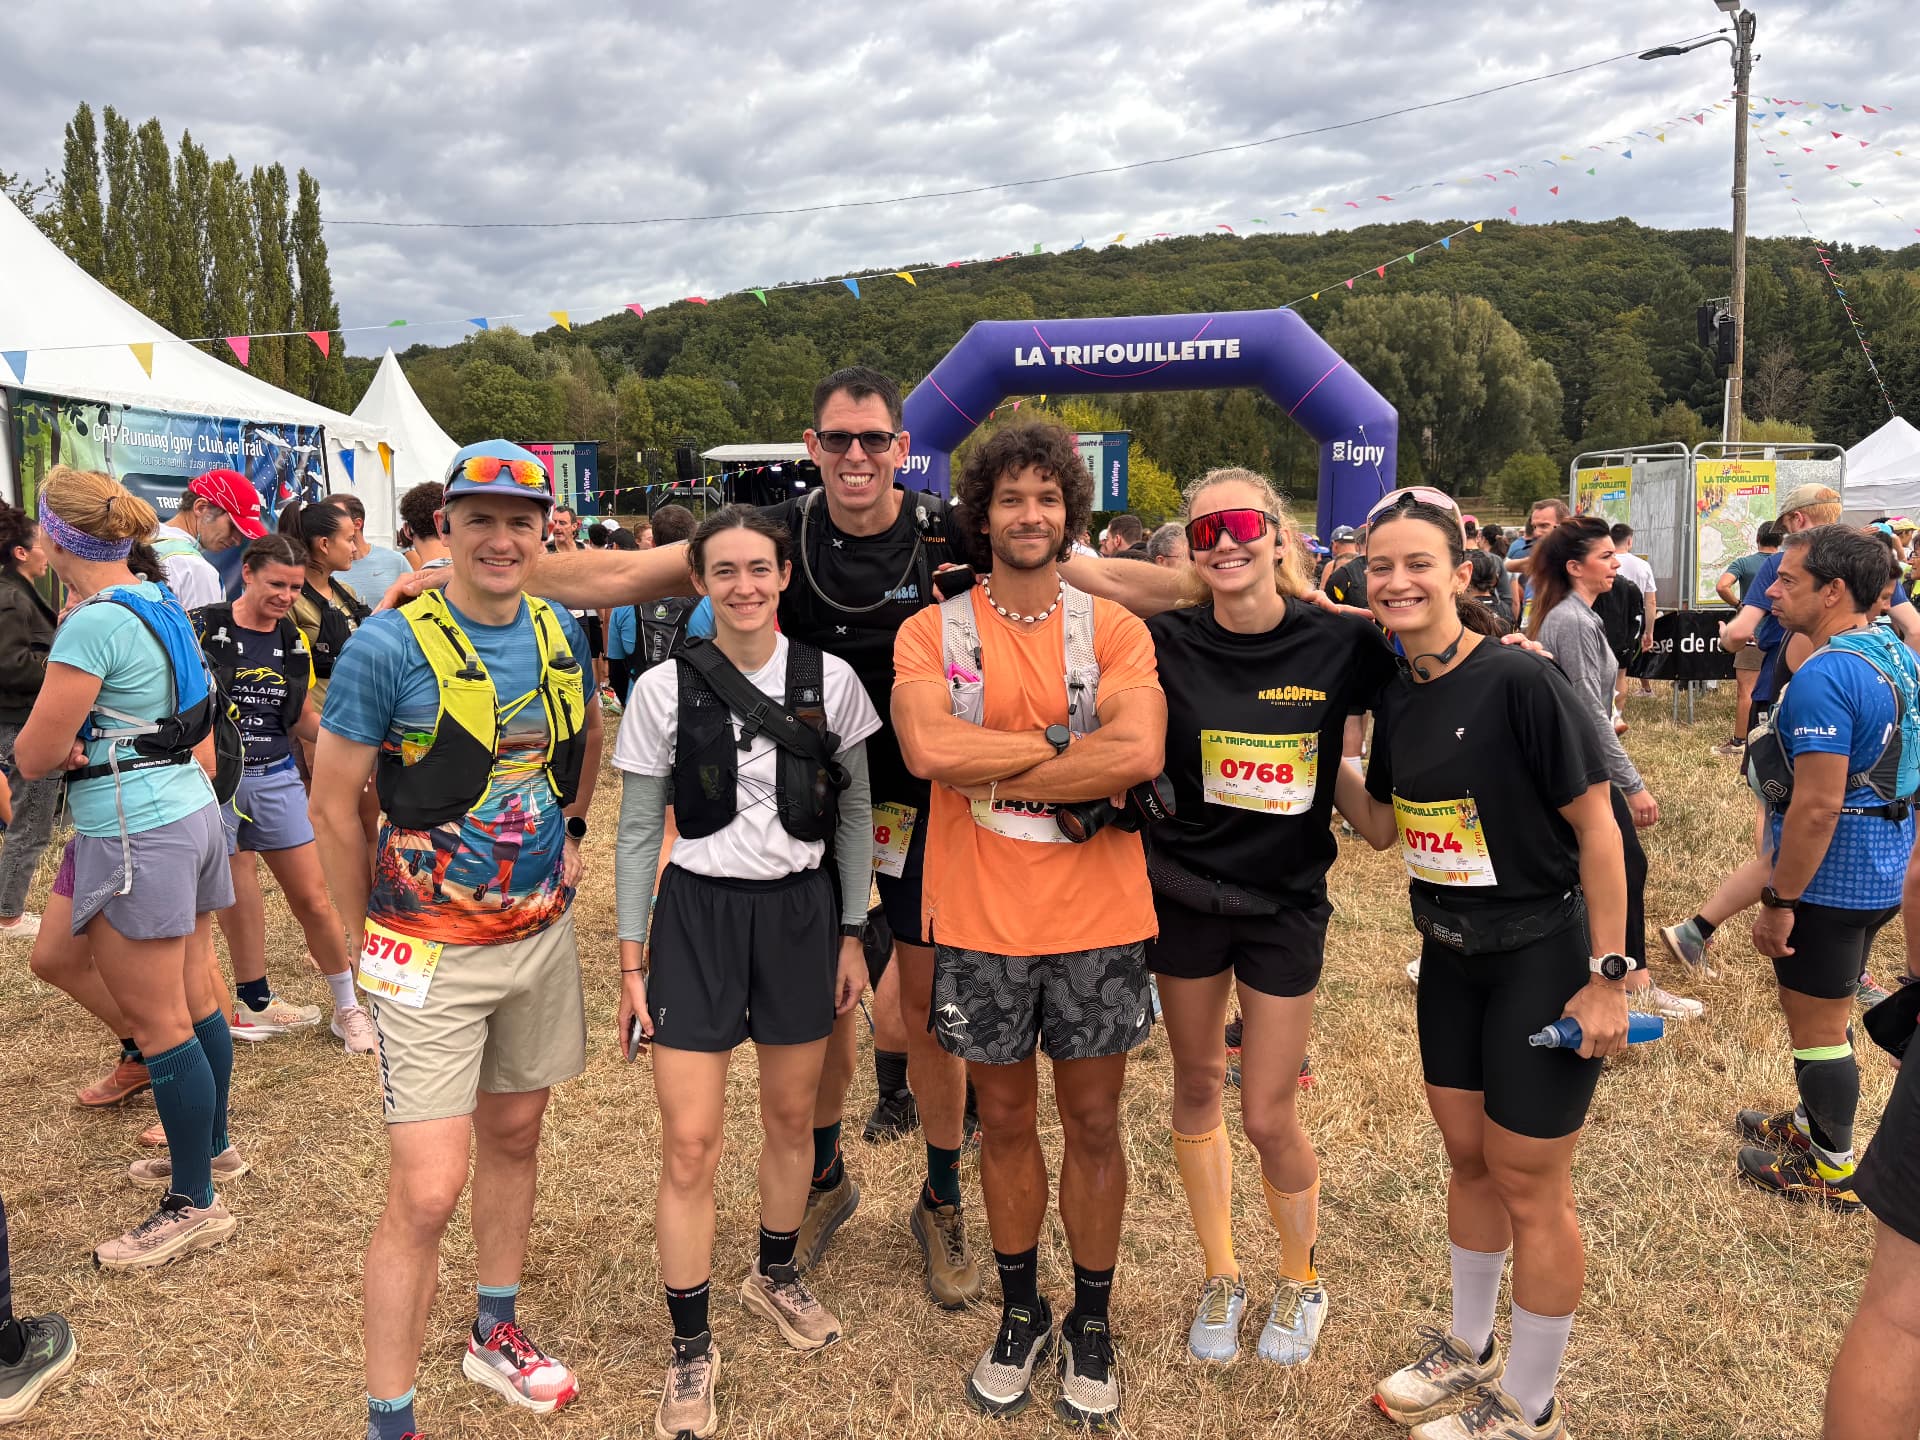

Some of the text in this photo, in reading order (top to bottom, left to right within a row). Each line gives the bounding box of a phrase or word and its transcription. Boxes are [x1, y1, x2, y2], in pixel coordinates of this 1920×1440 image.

[1015, 338, 1240, 366] LA TRIFOUILLETTE
[93, 424, 265, 457] CAP Running Igny Club de Trail
[1347, 440, 1385, 466] igny
[901, 456, 931, 474] gny
[1715, 475, 1769, 483] TRIFOUILLETTE
[1680, 632, 1705, 653] de
[1258, 686, 1327, 701] KM&COFFEE
[1209, 735, 1299, 748] LA TRIFOUILLETTE
[1220, 758, 1294, 784] 0768
[1406, 827, 1463, 853] 0724
[422, 950, 438, 979] 17 Km
